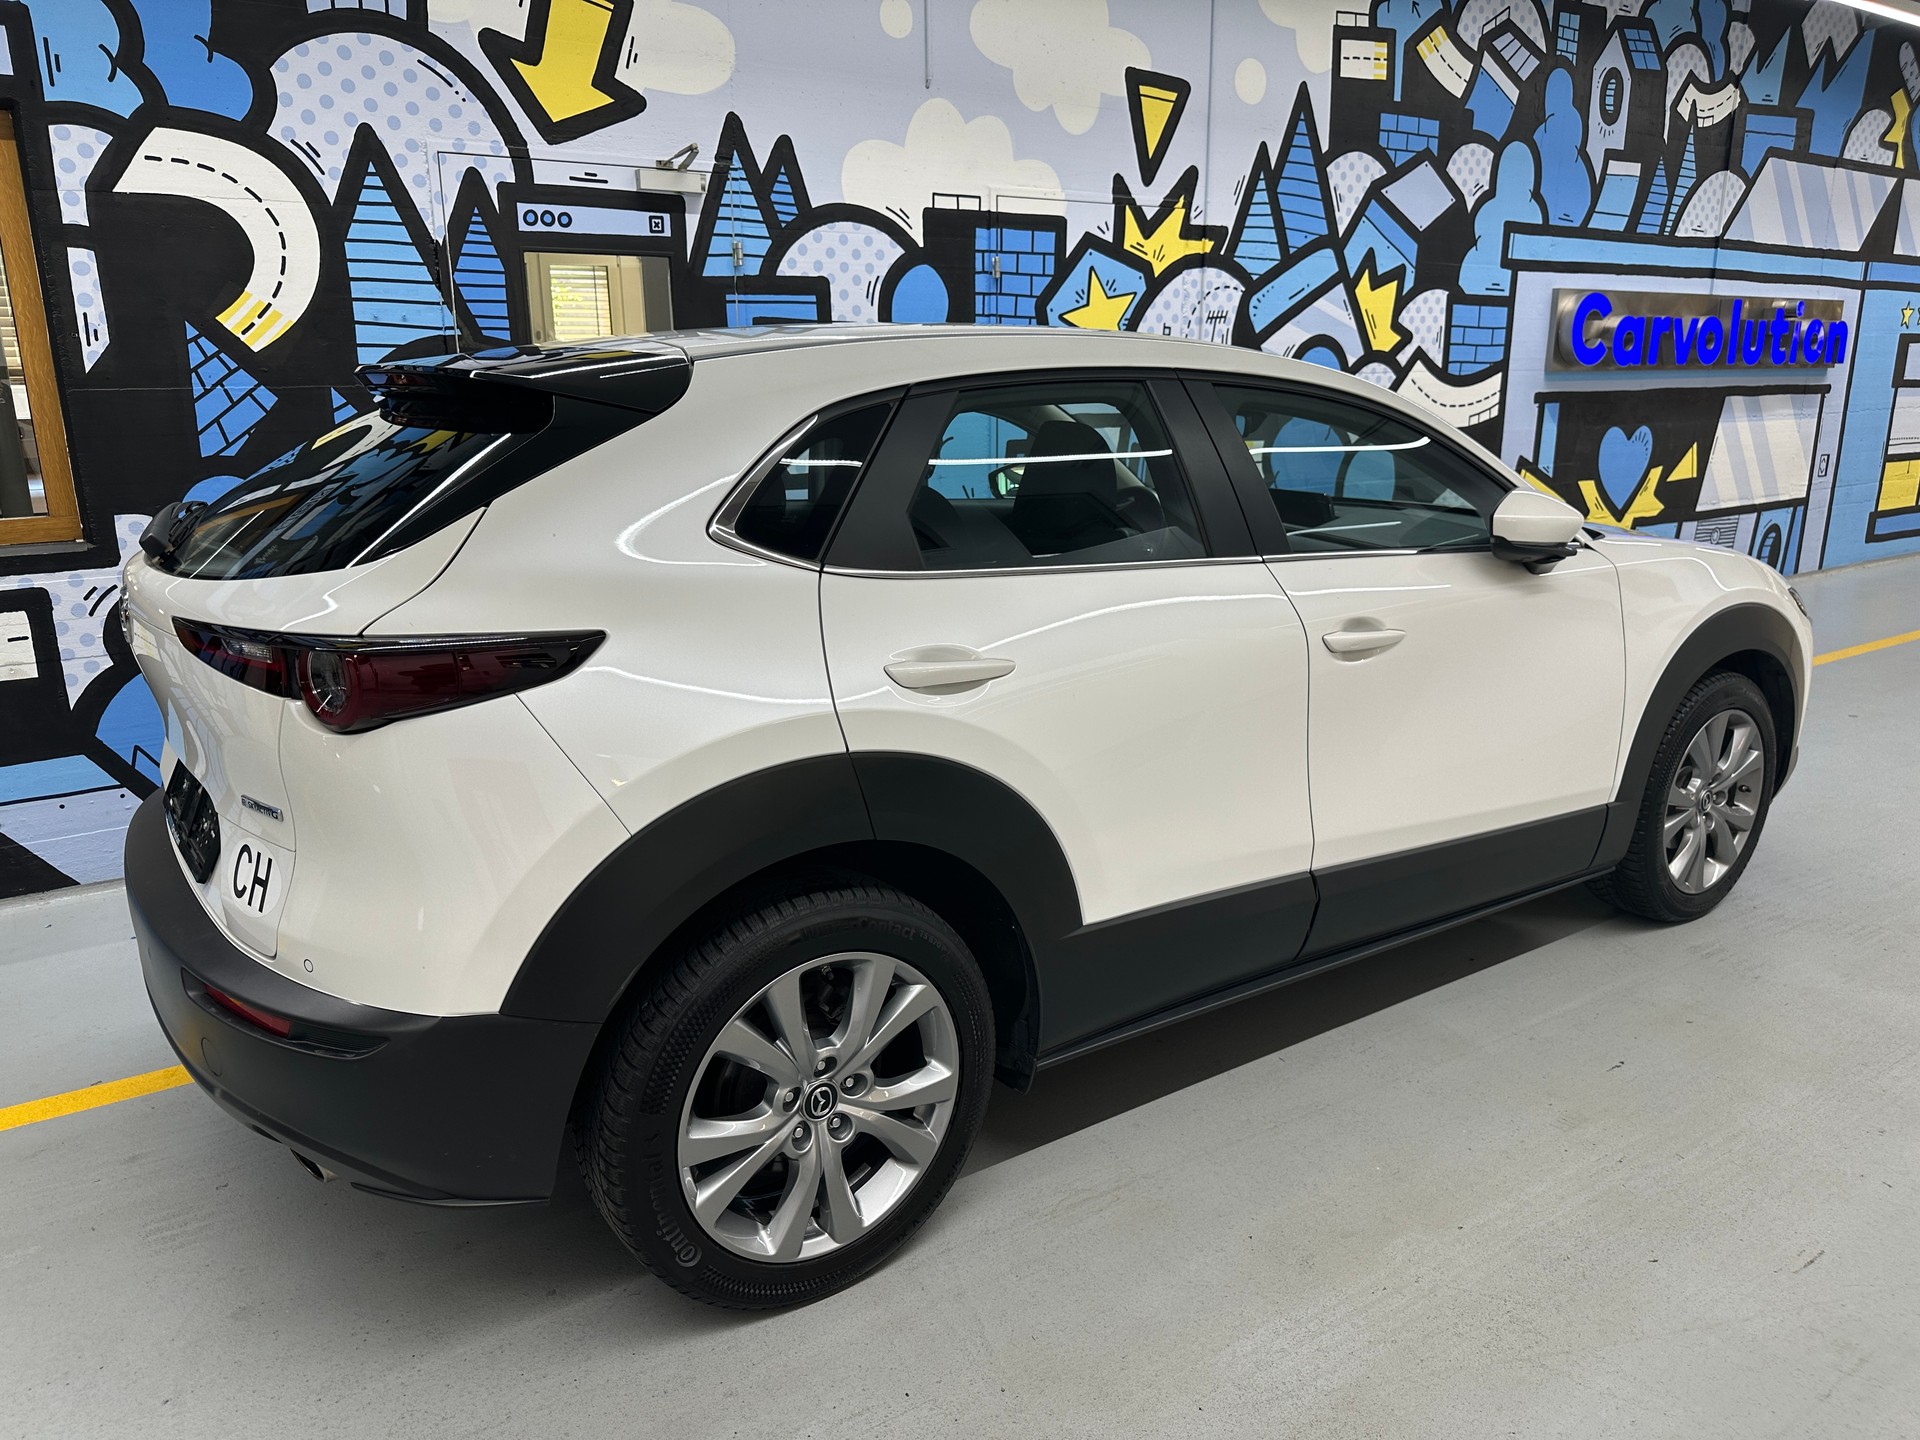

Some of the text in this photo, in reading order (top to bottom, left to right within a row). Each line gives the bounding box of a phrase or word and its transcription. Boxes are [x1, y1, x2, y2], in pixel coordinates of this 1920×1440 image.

[1572, 292, 1849, 367] Carvolution
[233, 844, 272, 913] CH
[640, 1151, 703, 1268] Continental
